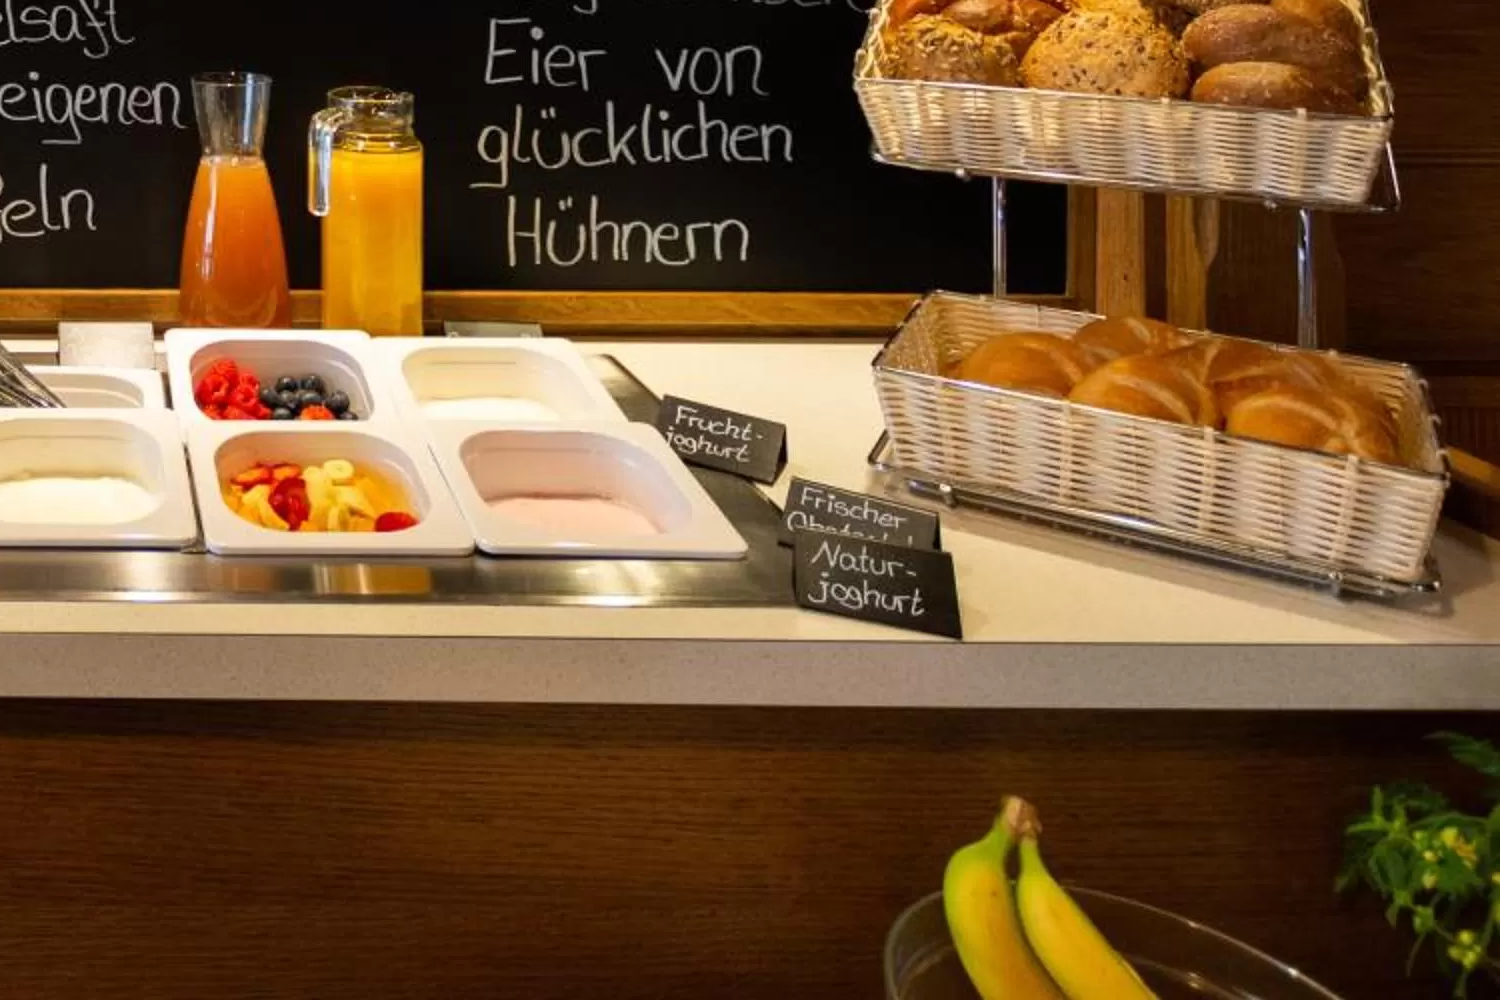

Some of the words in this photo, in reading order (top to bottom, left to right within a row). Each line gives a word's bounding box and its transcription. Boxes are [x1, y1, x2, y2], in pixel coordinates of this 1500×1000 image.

[484, 17, 606, 90] Eier
[655, 46, 769, 96] von
[469, 99, 793, 188] glücklichen
[507, 195, 749, 267] Hühnern
[665, 424, 751, 463] joghurt
[800, 486, 908, 530] Frischer
[807, 571, 925, 617] joghurt
